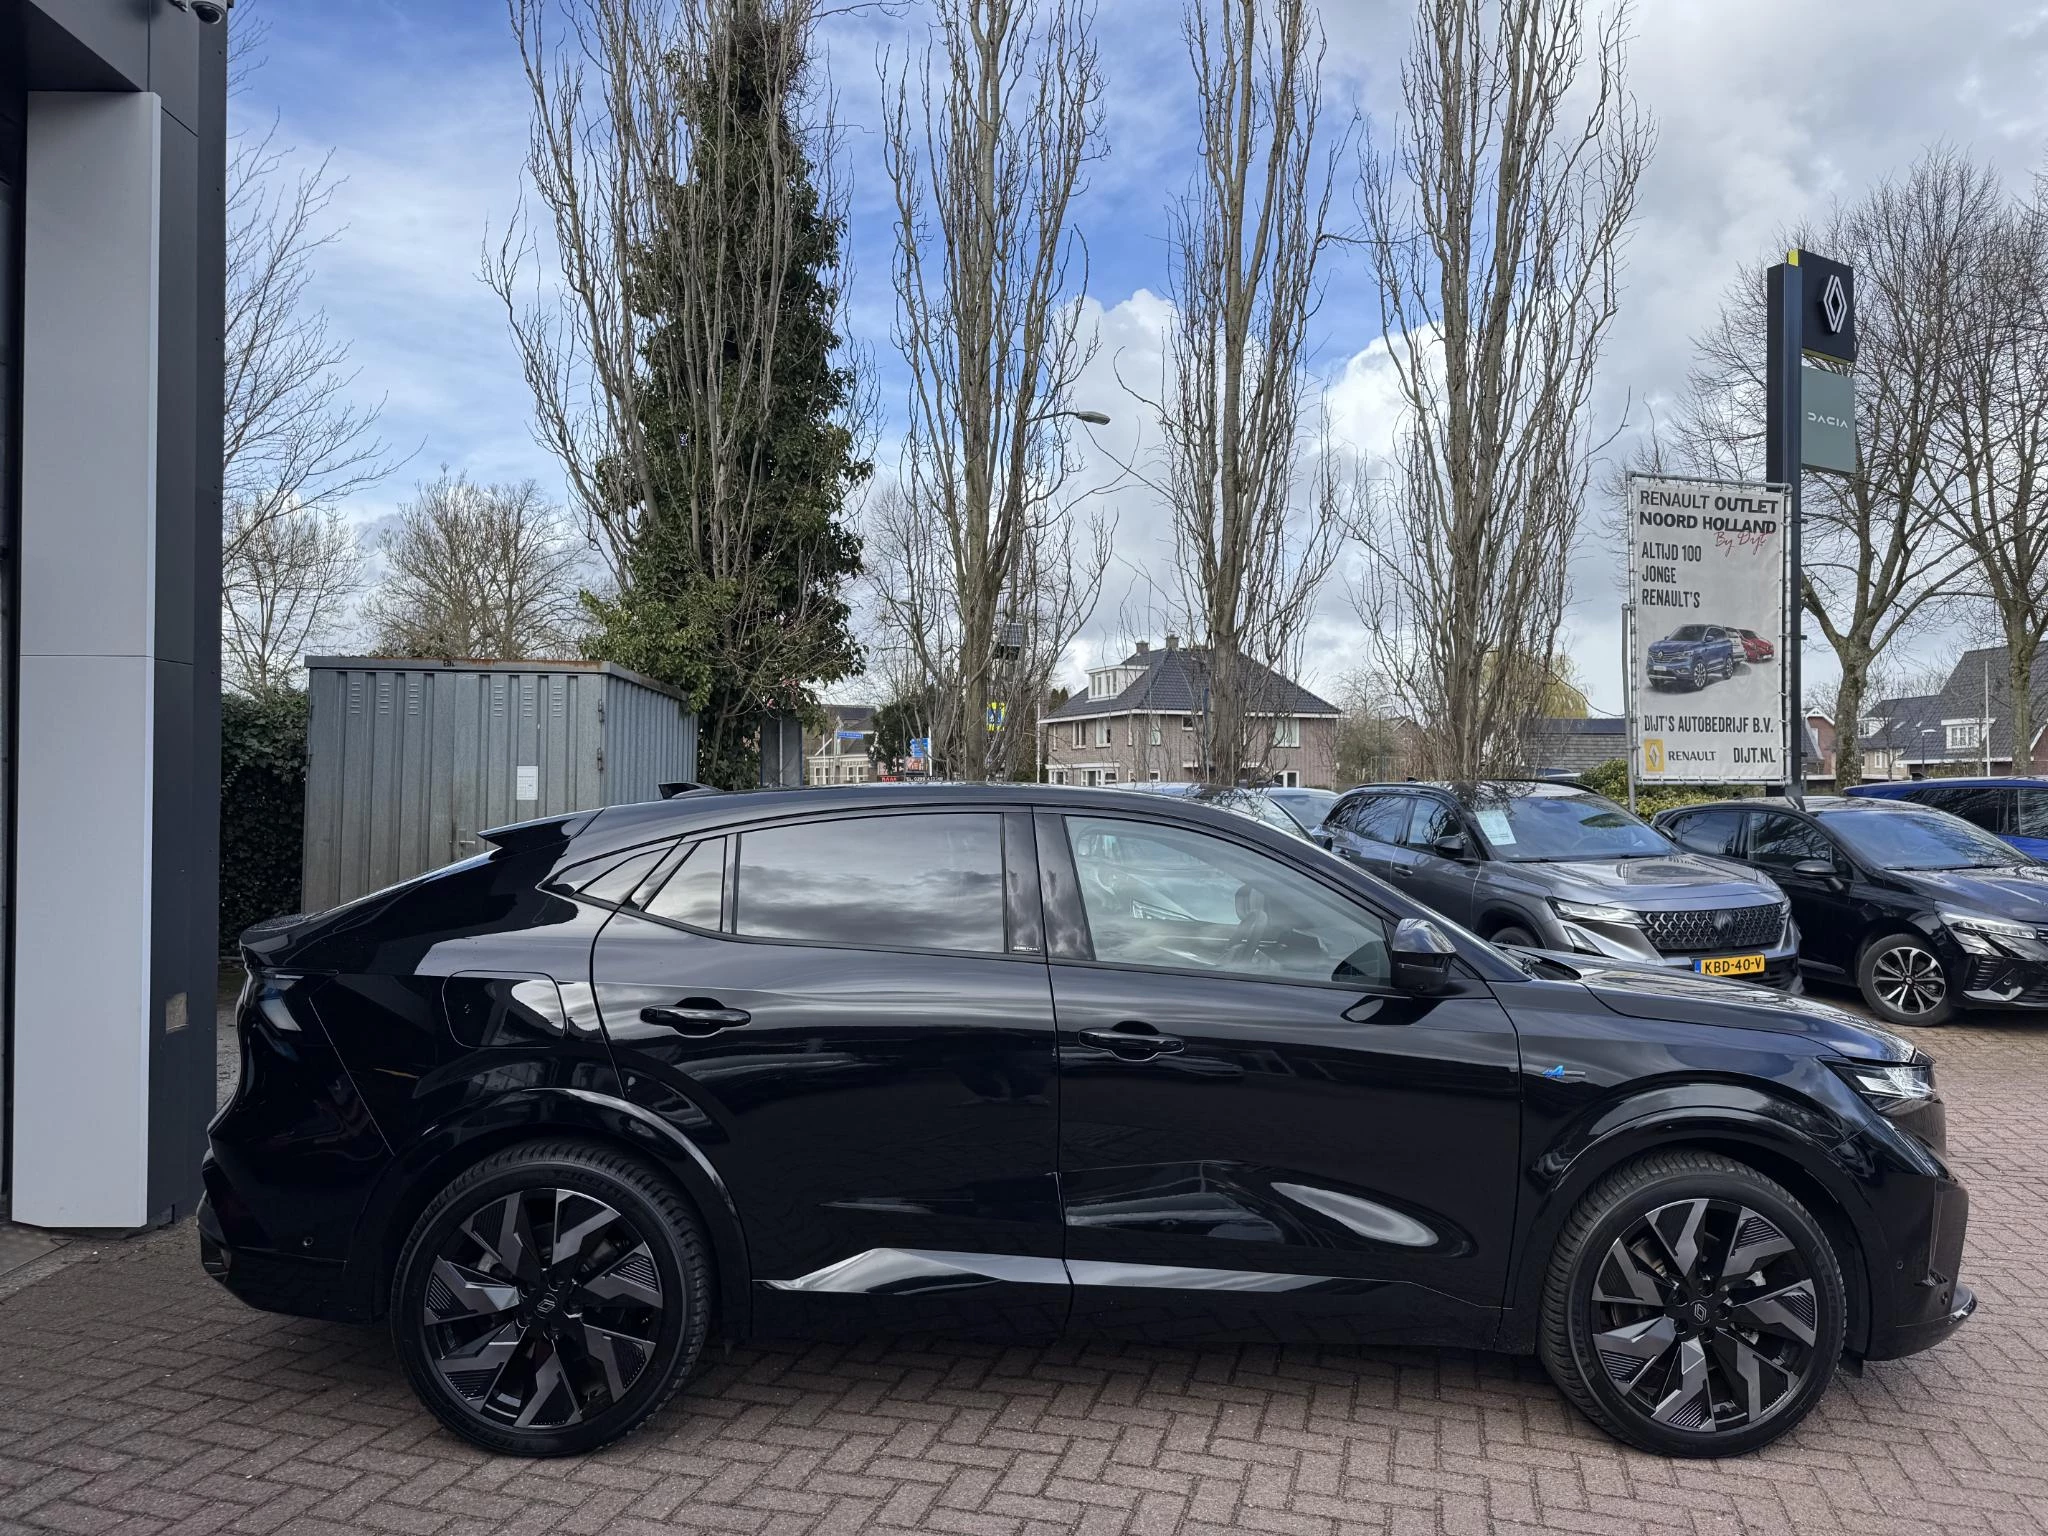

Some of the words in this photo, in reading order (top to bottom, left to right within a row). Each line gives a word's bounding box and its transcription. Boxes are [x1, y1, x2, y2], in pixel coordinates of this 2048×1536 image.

[1807, 411, 1848, 429] DACIA
[1640, 490, 1709, 510] RENAULT
[1714, 496, 1778, 514] OUTLET
[1640, 511, 1698, 529] NOORD
[1702, 515, 1777, 534] HOLLAND
[1641, 541, 1679, 561] ALTIJD
[1681, 545, 1702, 562] 100
[1714, 531, 1735, 557] By
[1642, 565, 1677, 584] JONGE
[1642, 588, 1701, 609] RENAULT'S
[1644, 715, 1675, 732] DIJT'S
[1677, 715, 1749, 733] AUTOBEDRIJF
[1752, 717, 1774, 733] B.V.
[1668, 750, 1716, 761] RENAULT
[1733, 747, 1776, 763] DIJT.NL
[1704, 957, 1762, 974] KBD-40-V
